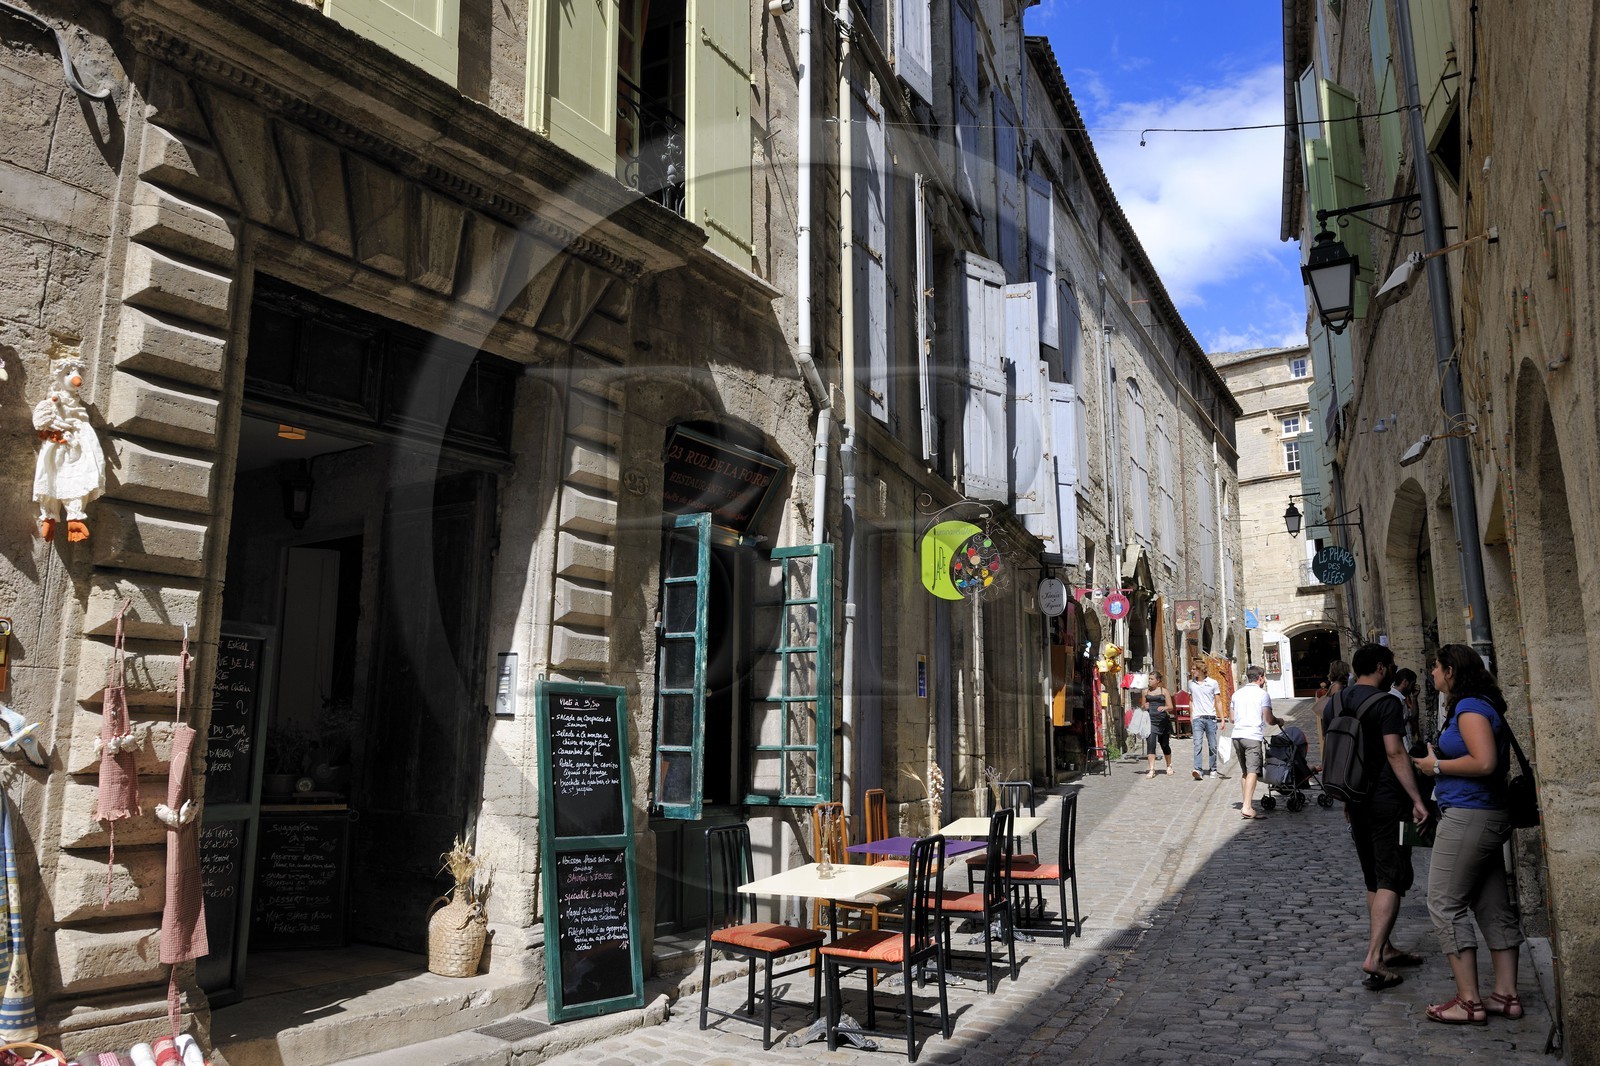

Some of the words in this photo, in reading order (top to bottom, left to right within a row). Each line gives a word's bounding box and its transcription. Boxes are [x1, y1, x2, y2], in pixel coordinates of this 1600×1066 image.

[669, 445, 684, 460] 23
[686, 450, 710, 469] RUE
[707, 458, 723, 472] DE
[723, 463, 737, 478] LA
[739, 468, 769, 487] FOIRE
[669, 471, 723, 494] RESTAURANT
[1318, 550, 1328, 564] LE
[1329, 546, 1354, 567] PHARE
[1328, 562, 1340, 570] DES
[1323, 570, 1345, 584] ELFES
[230, 658, 242, 669] DE
[245, 659, 256, 670] LA
[213, 725, 224, 735] DU
